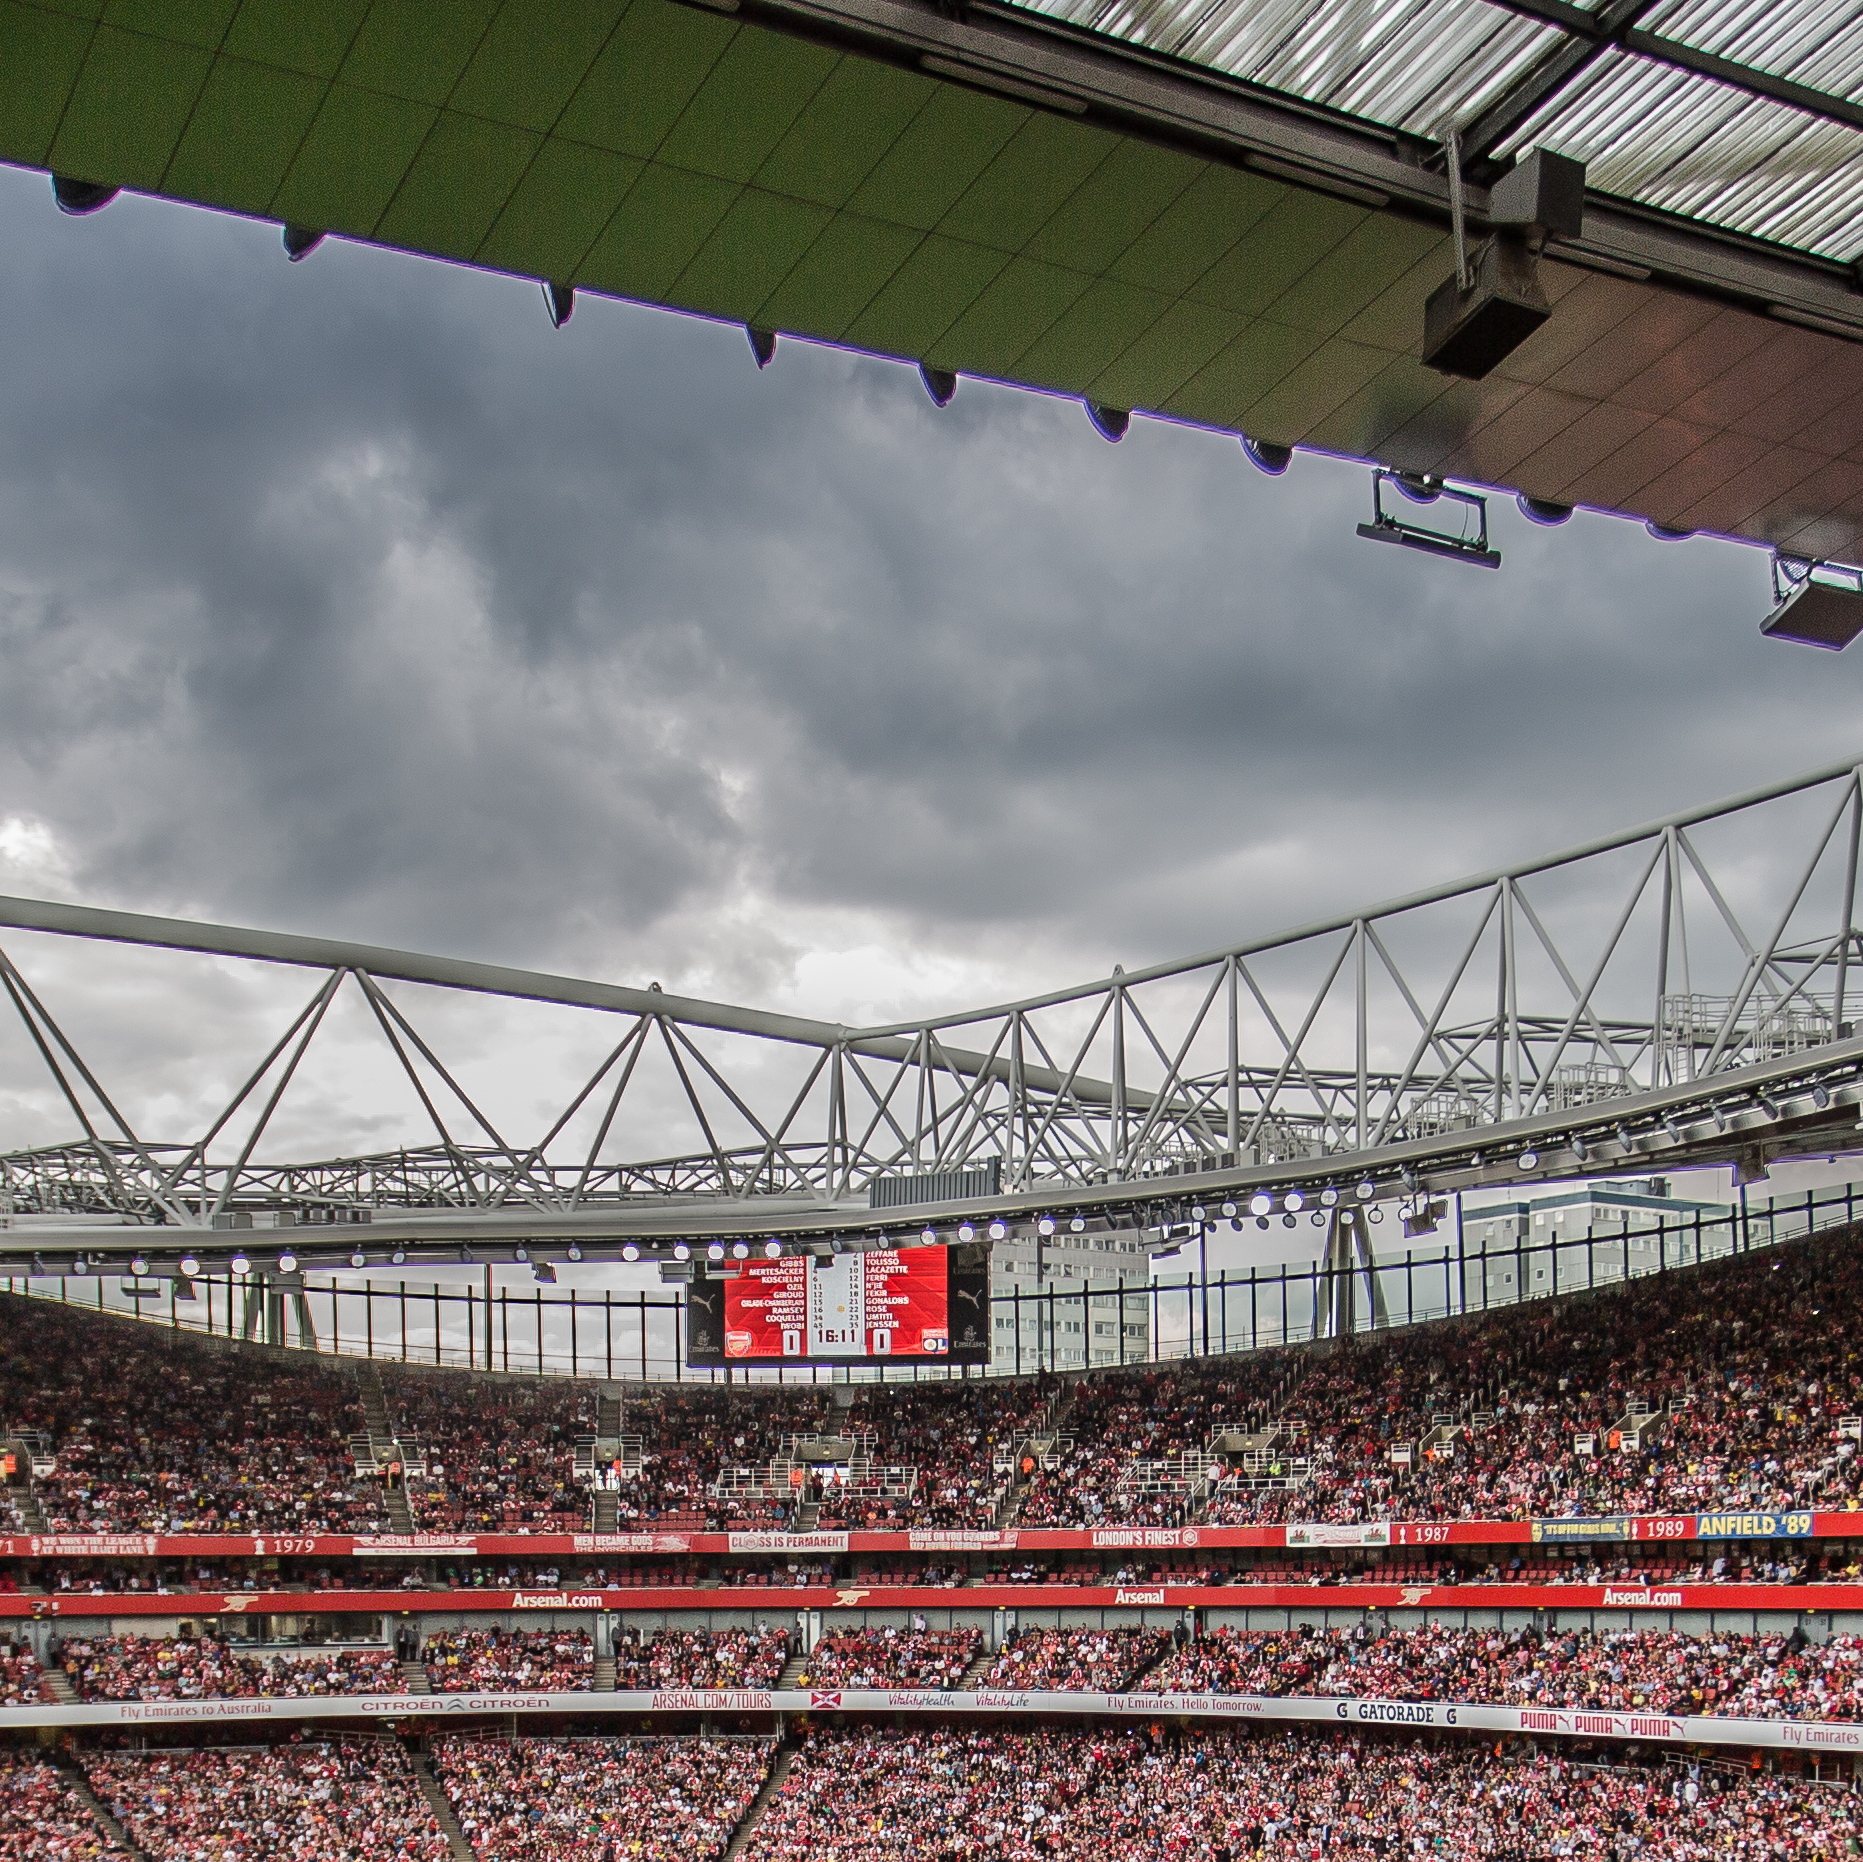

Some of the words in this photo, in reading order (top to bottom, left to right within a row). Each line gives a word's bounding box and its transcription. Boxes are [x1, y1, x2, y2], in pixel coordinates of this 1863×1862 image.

[818, 1329, 856, 1343] 16:11
[1647, 1520, 1685, 1538] 1989
[1698, 1516, 1776, 1536] ANFIELD
[1781, 1514, 1811, 1533] '89
[374, 1535, 413, 1546] ARSENAL
[731, 1536, 772, 1549] CLSS
[773, 1537, 785, 1548] IS
[787, 1535, 845, 1549] PERMANENT
[1092, 1530, 1143, 1546] LONDON'S
[1144, 1530, 1180, 1545] FINEST
[1415, 1527, 1449, 1542] 1987
[273, 1539, 315, 1553] 1979
[512, 1593, 603, 1608] Arsenal.com
[1115, 1588, 1165, 1605] Arsenal
[1603, 1588, 1682, 1607] Arsenal.com
[651, 1692, 773, 1709] ARSENAL.COM/TOURS
[888, 1693, 956, 1708] VitalityHealth
[975, 1693, 1030, 1708] VitalityLife
[1107, 1696, 1125, 1713] Fly
[1127, 1696, 1178, 1711] Emirates.
[1182, 1697, 1209, 1711] Hello
[1211, 1698, 1265, 1713] Tomorrow.
[120, 1706, 139, 1719] Fly
[216, 1702, 272, 1715] Australia
[1358, 1703, 1434, 1724] GATORADE
[1520, 1712, 1558, 1731] PUMA
[1574, 1716, 1613, 1735] PUMA
[1630, 1718, 1671, 1738] PUMA
[1782, 1727, 1804, 1745] Fly
[1806, 1728, 1859, 1746] Emirates
